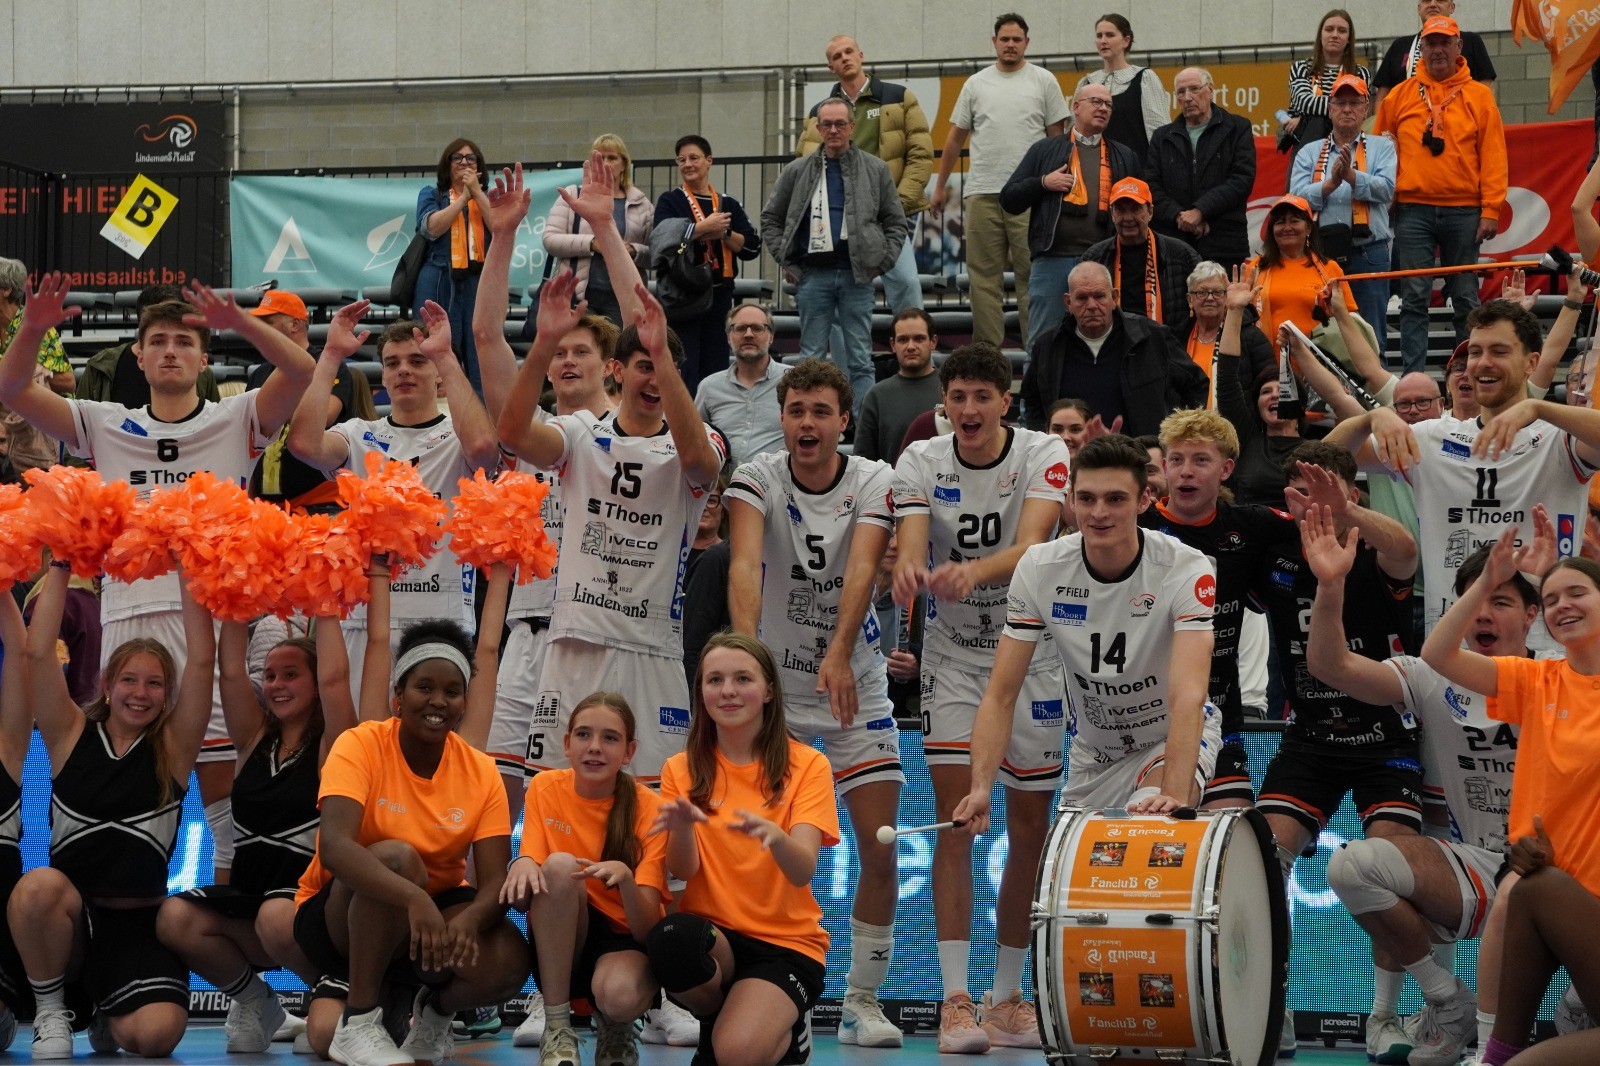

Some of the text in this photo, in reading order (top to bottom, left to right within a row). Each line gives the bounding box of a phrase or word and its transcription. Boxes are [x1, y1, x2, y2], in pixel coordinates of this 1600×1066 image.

[1235, 86, 1260, 112] op
[125, 187, 162, 228] B
[157, 439, 179, 462] 6
[151, 469, 210, 484] Tho
[611, 462, 643, 499] 15
[1476, 468, 1498, 499] 11
[605, 502, 662, 526] Thoen
[1466, 508, 1525, 524] Thoen
[957, 512, 1001, 549] 20
[609, 535, 658, 550] IVECO
[590, 548, 654, 569] CAMMAERT
[806, 534, 826, 571] 5
[389, 574, 440, 593] emanS
[811, 576, 843, 593] hoe
[1066, 587, 1090, 598] FiELD
[1214, 600, 1239, 615] oen
[795, 617, 837, 631] CAMMA
[951, 627, 999, 649] Lindem
[782, 649, 819, 675] Linde
[1090, 632, 1126, 673] 14
[1090, 675, 1158, 696] Thoen
[1306, 691, 1348, 699] CAMMA
[1108, 699, 1164, 716] IVECO
[1093, 714, 1167, 731] CAMMAERT
[1324, 722, 1385, 746] demanS
[1462, 722, 1518, 752] 24
[526, 733, 544, 760] 15
[1478, 758, 1515, 773] Tho
[1090, 876, 1138, 889] FancluB
[1108, 949, 1156, 963] FancluB
[189, 991, 231, 1011] PYTEC
[814, 1004, 842, 1012] screen
[903, 1005, 935, 1014] screens
[1088, 1016, 1136, 1029] FancluB
[1323, 1018, 1357, 1027] screens
